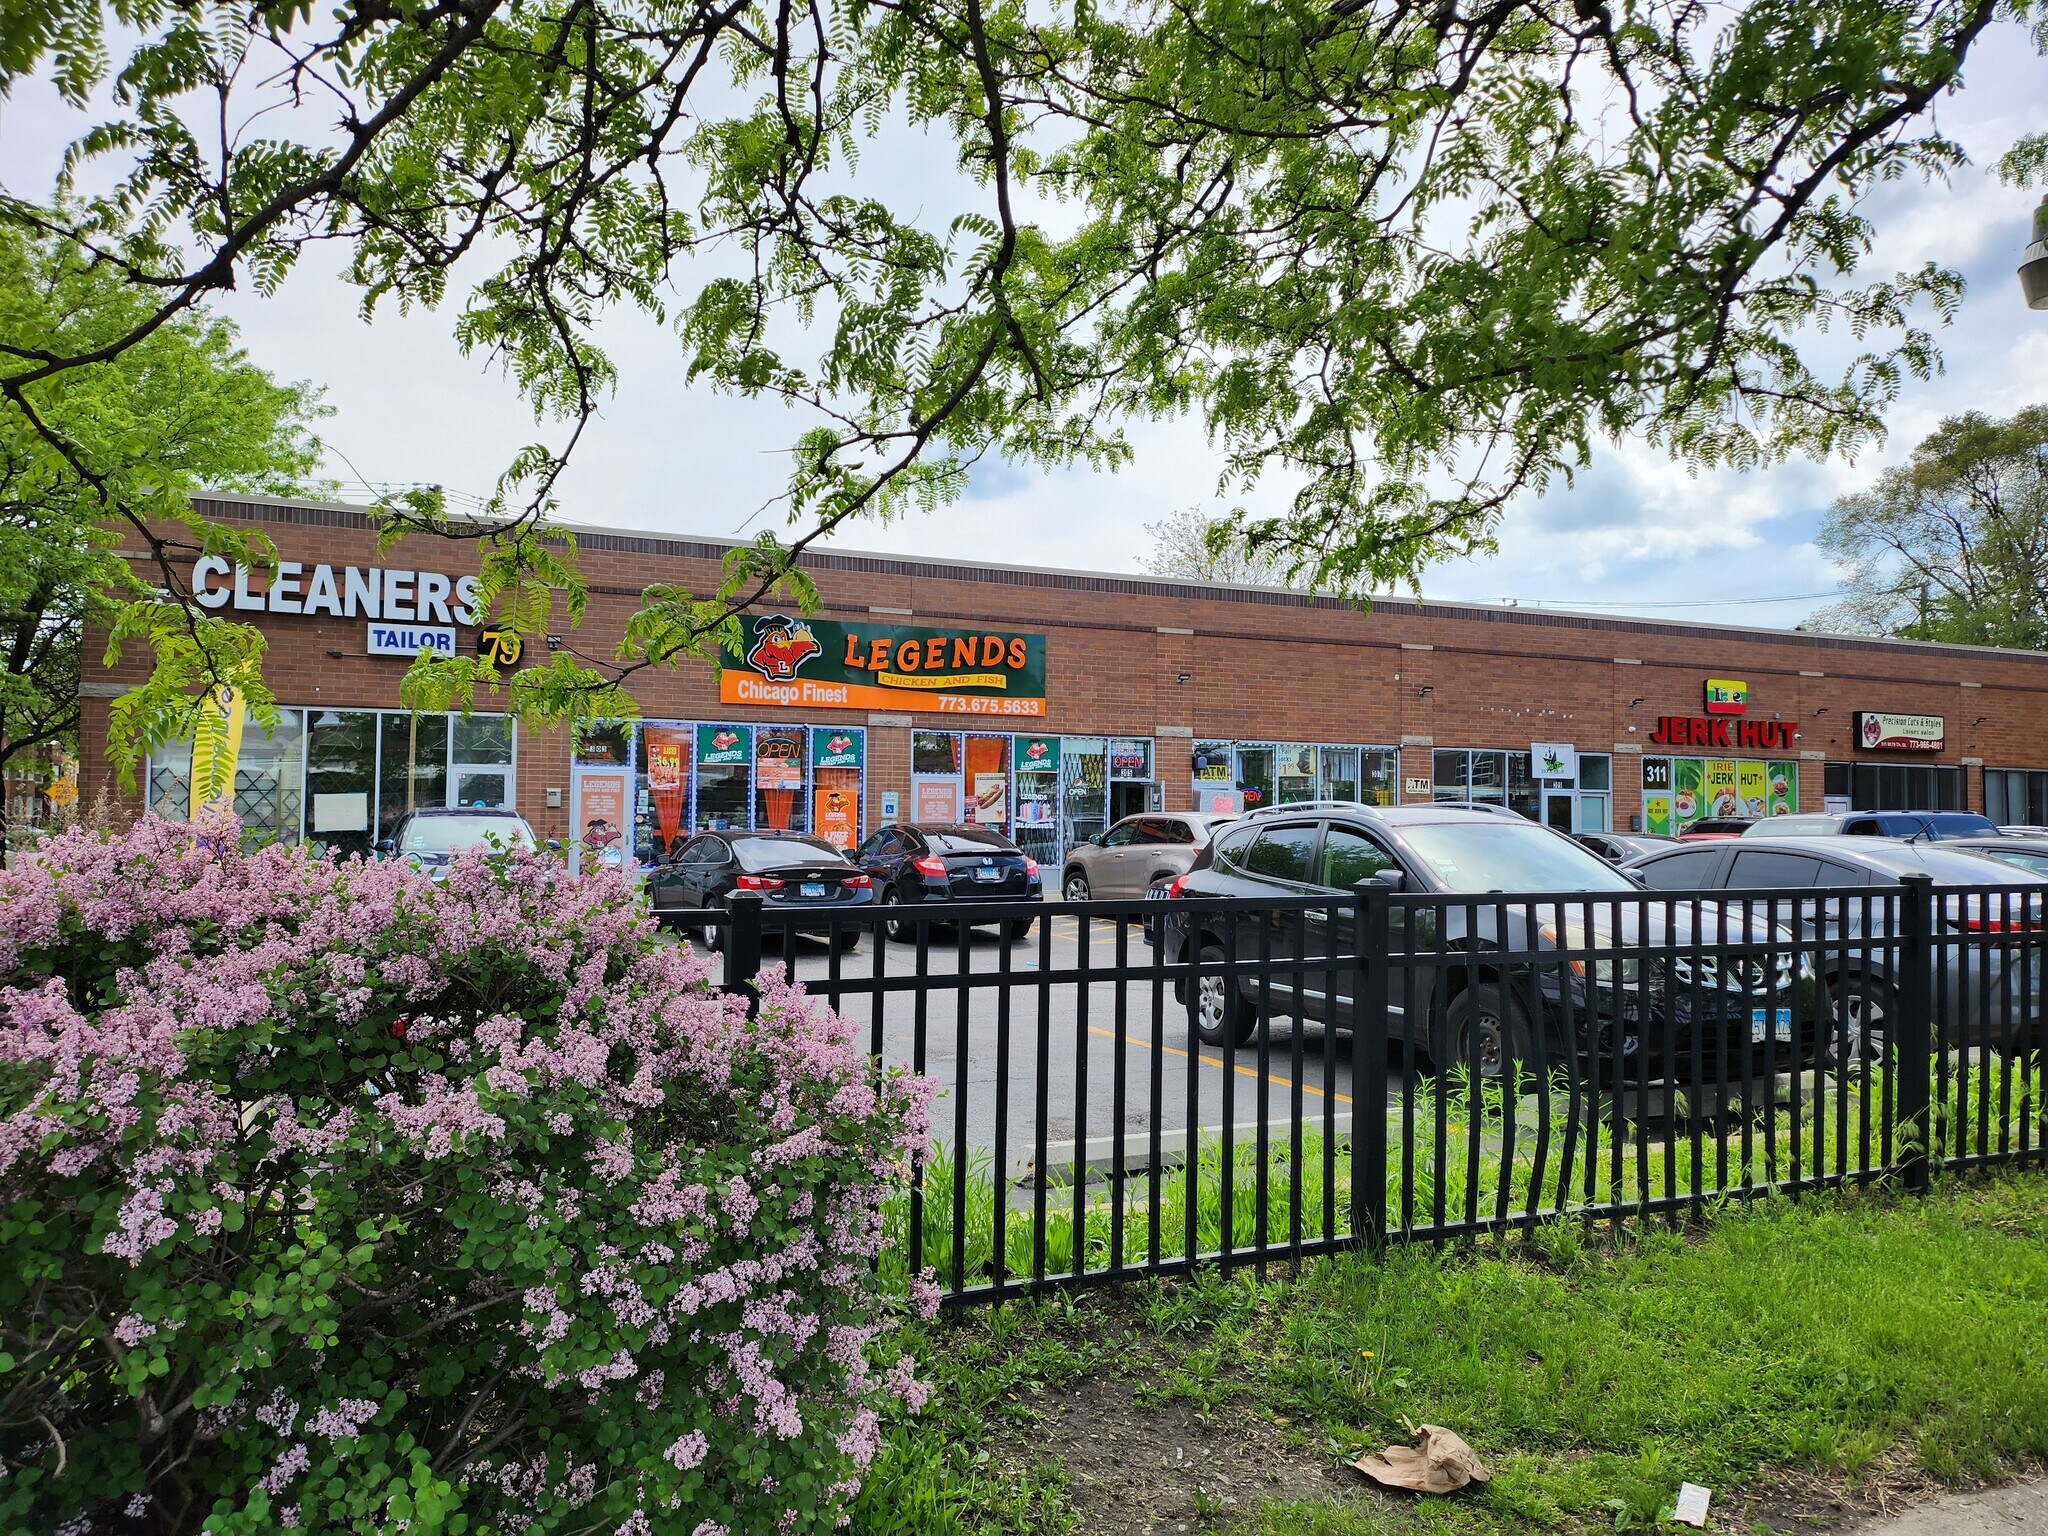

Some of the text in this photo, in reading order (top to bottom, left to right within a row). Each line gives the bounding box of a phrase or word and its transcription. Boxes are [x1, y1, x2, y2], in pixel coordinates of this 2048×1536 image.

[191, 555, 480, 626] CLEANERS
[373, 629, 450, 651] TAILOR
[482, 631, 522, 665] 79
[844, 633, 1027, 672] LEGENDS
[881, 675, 1004, 686] CHICKEN AND FISH
[737, 679, 848, 705] Chicago Finest
[938, 696, 1039, 715] 773.675.5633
[1882, 715, 1907, 726] Precision
[1925, 718, 1942, 729] Styles
[1650, 715, 1798, 749] JERK HUT
[704, 750, 743, 760] LEGENDS
[757, 742, 800, 758] OPEN
[820, 754, 856, 763] LEGENDS
[1020, 758, 1052, 768] LEGENDS
[1114, 756, 1142, 768] OPEN
[1202, 766, 1226, 777] ATM
[1646, 766, 1666, 782] 311
[1712, 762, 1734, 772] IRIE
[1710, 772, 1758, 785] JERK HUT
[1244, 790, 1260, 802] PEN
